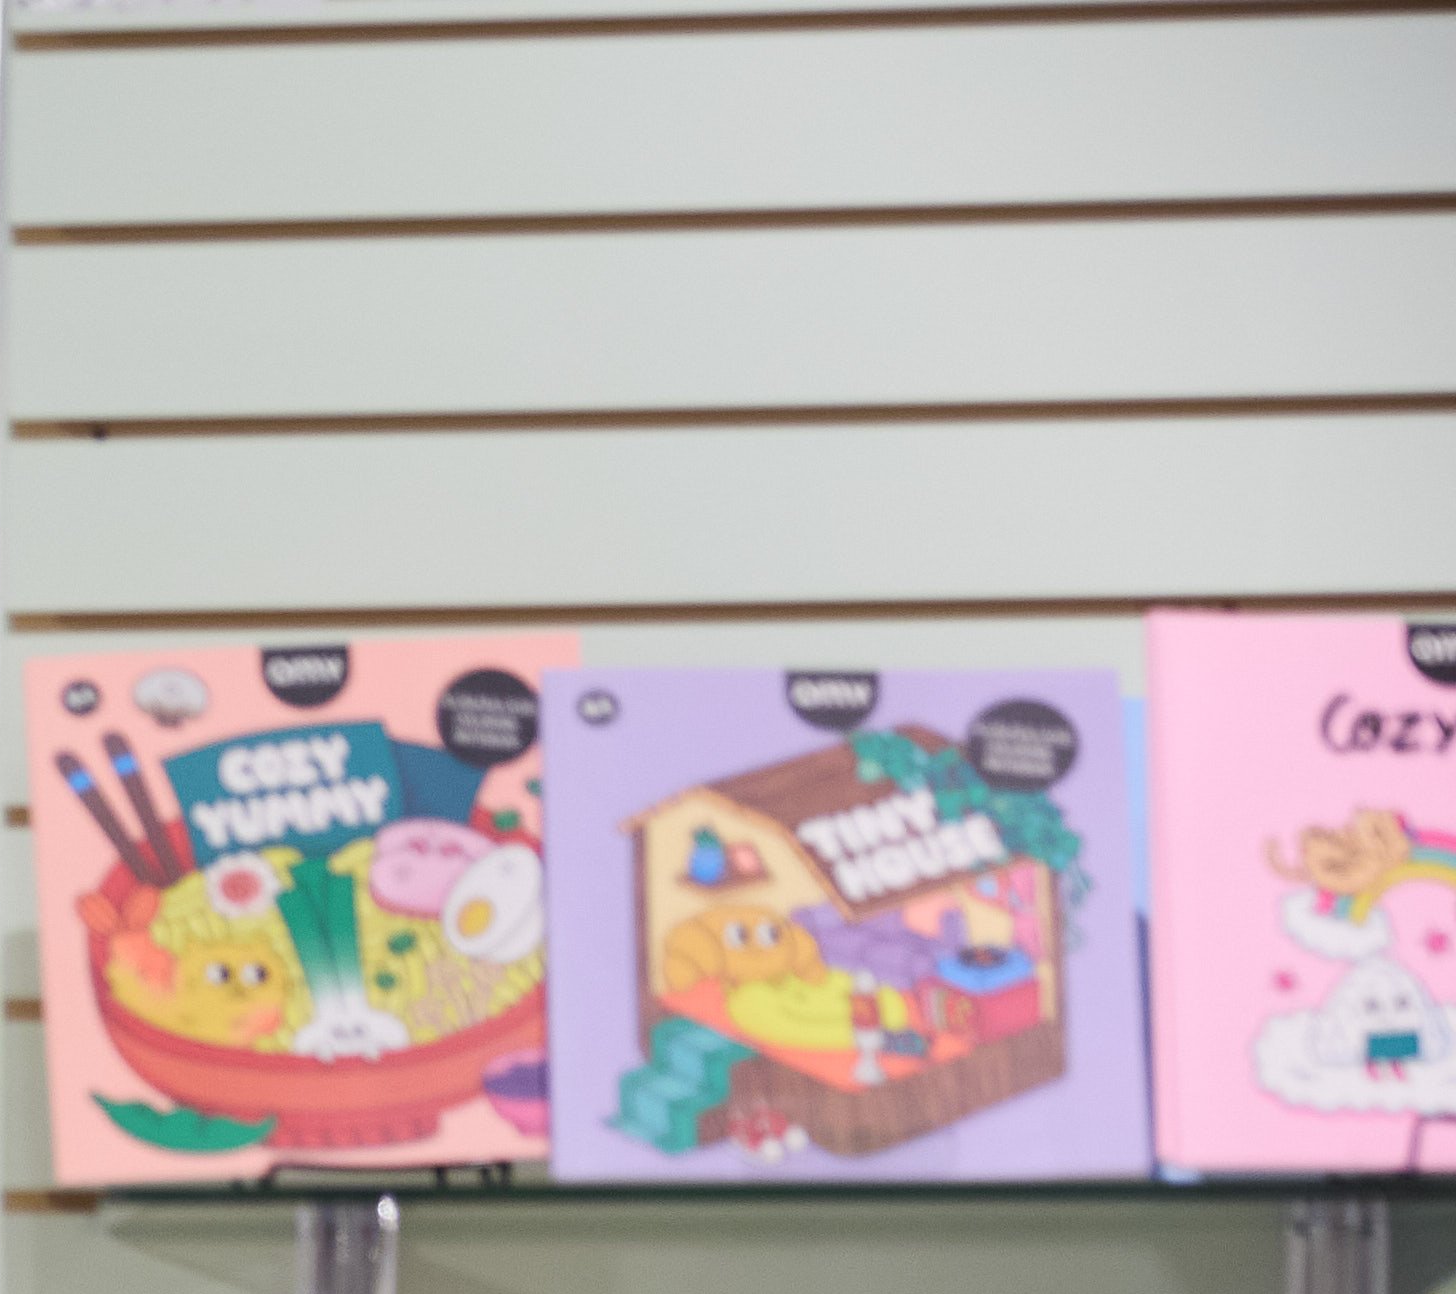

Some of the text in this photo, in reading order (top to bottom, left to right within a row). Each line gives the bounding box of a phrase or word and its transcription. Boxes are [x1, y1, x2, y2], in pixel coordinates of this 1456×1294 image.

[217, 733, 351, 796] COZY
[191, 774, 389, 850] YUMMY
[796, 788, 935, 862] TINY
[834, 814, 1008, 902] HOUSE
